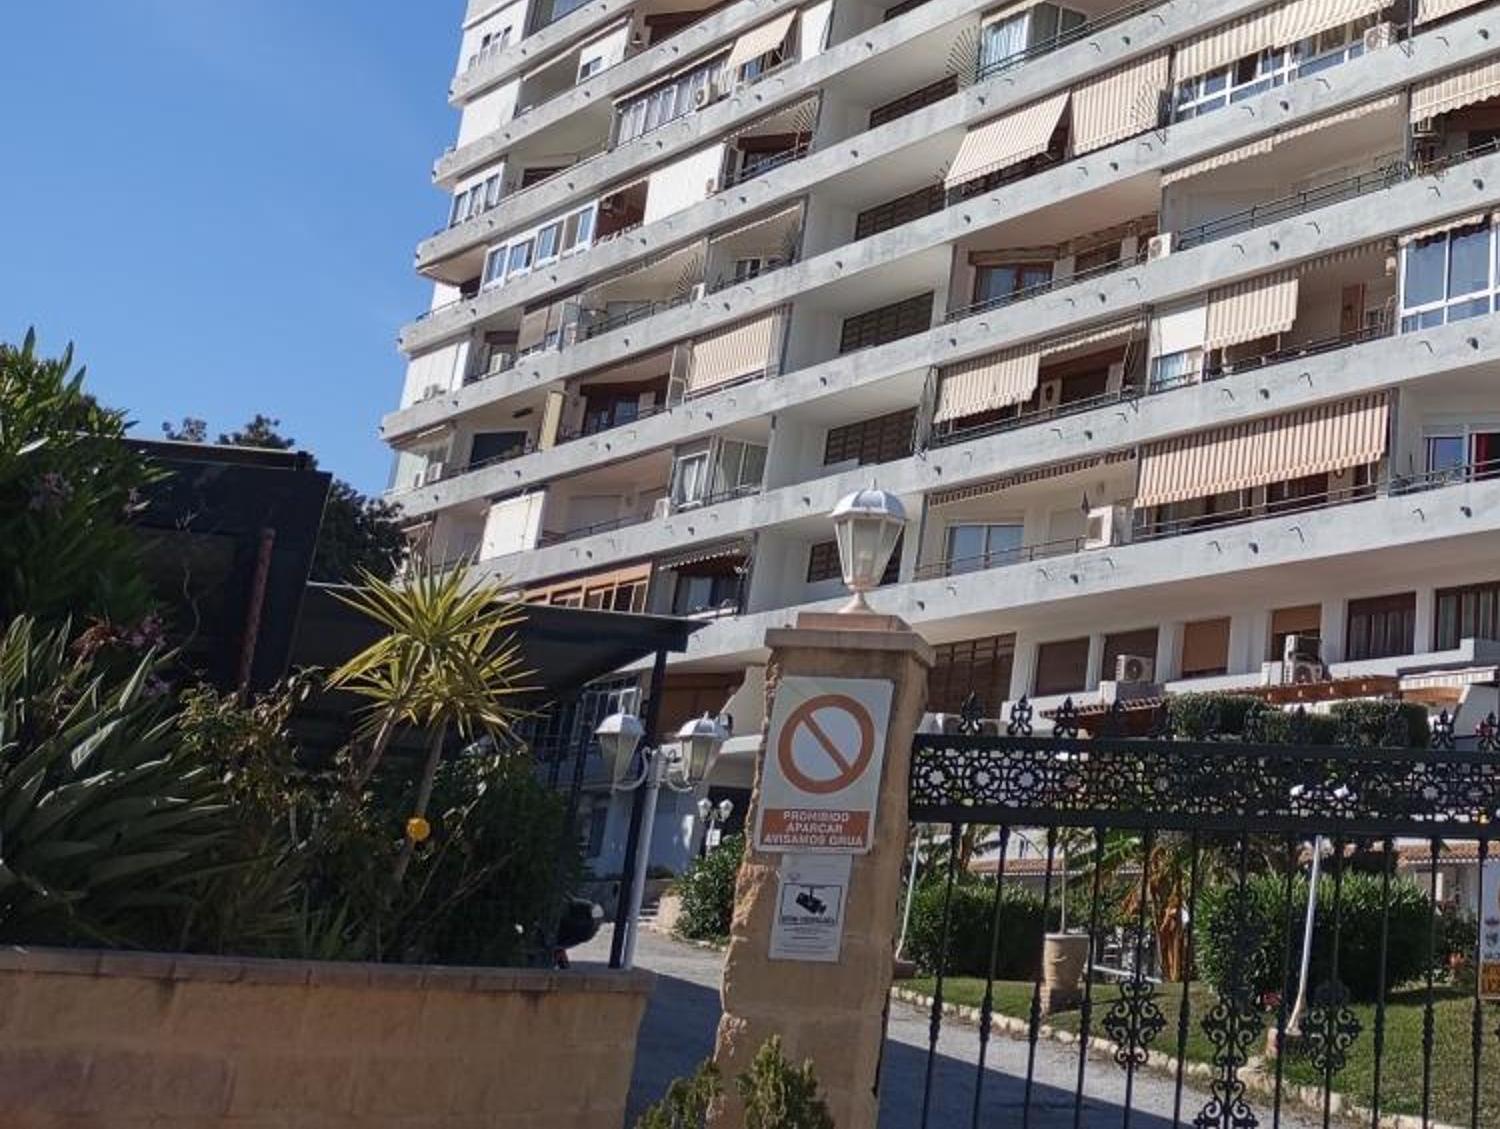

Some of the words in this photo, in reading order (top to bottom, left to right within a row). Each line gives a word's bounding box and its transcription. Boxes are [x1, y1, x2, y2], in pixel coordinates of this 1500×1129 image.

[783, 810, 849, 822] PROHIBIDO
[786, 822, 843, 834] APARCAR
[764, 833, 826, 845] AVISAMOS
[829, 835, 863, 847] GRUA
